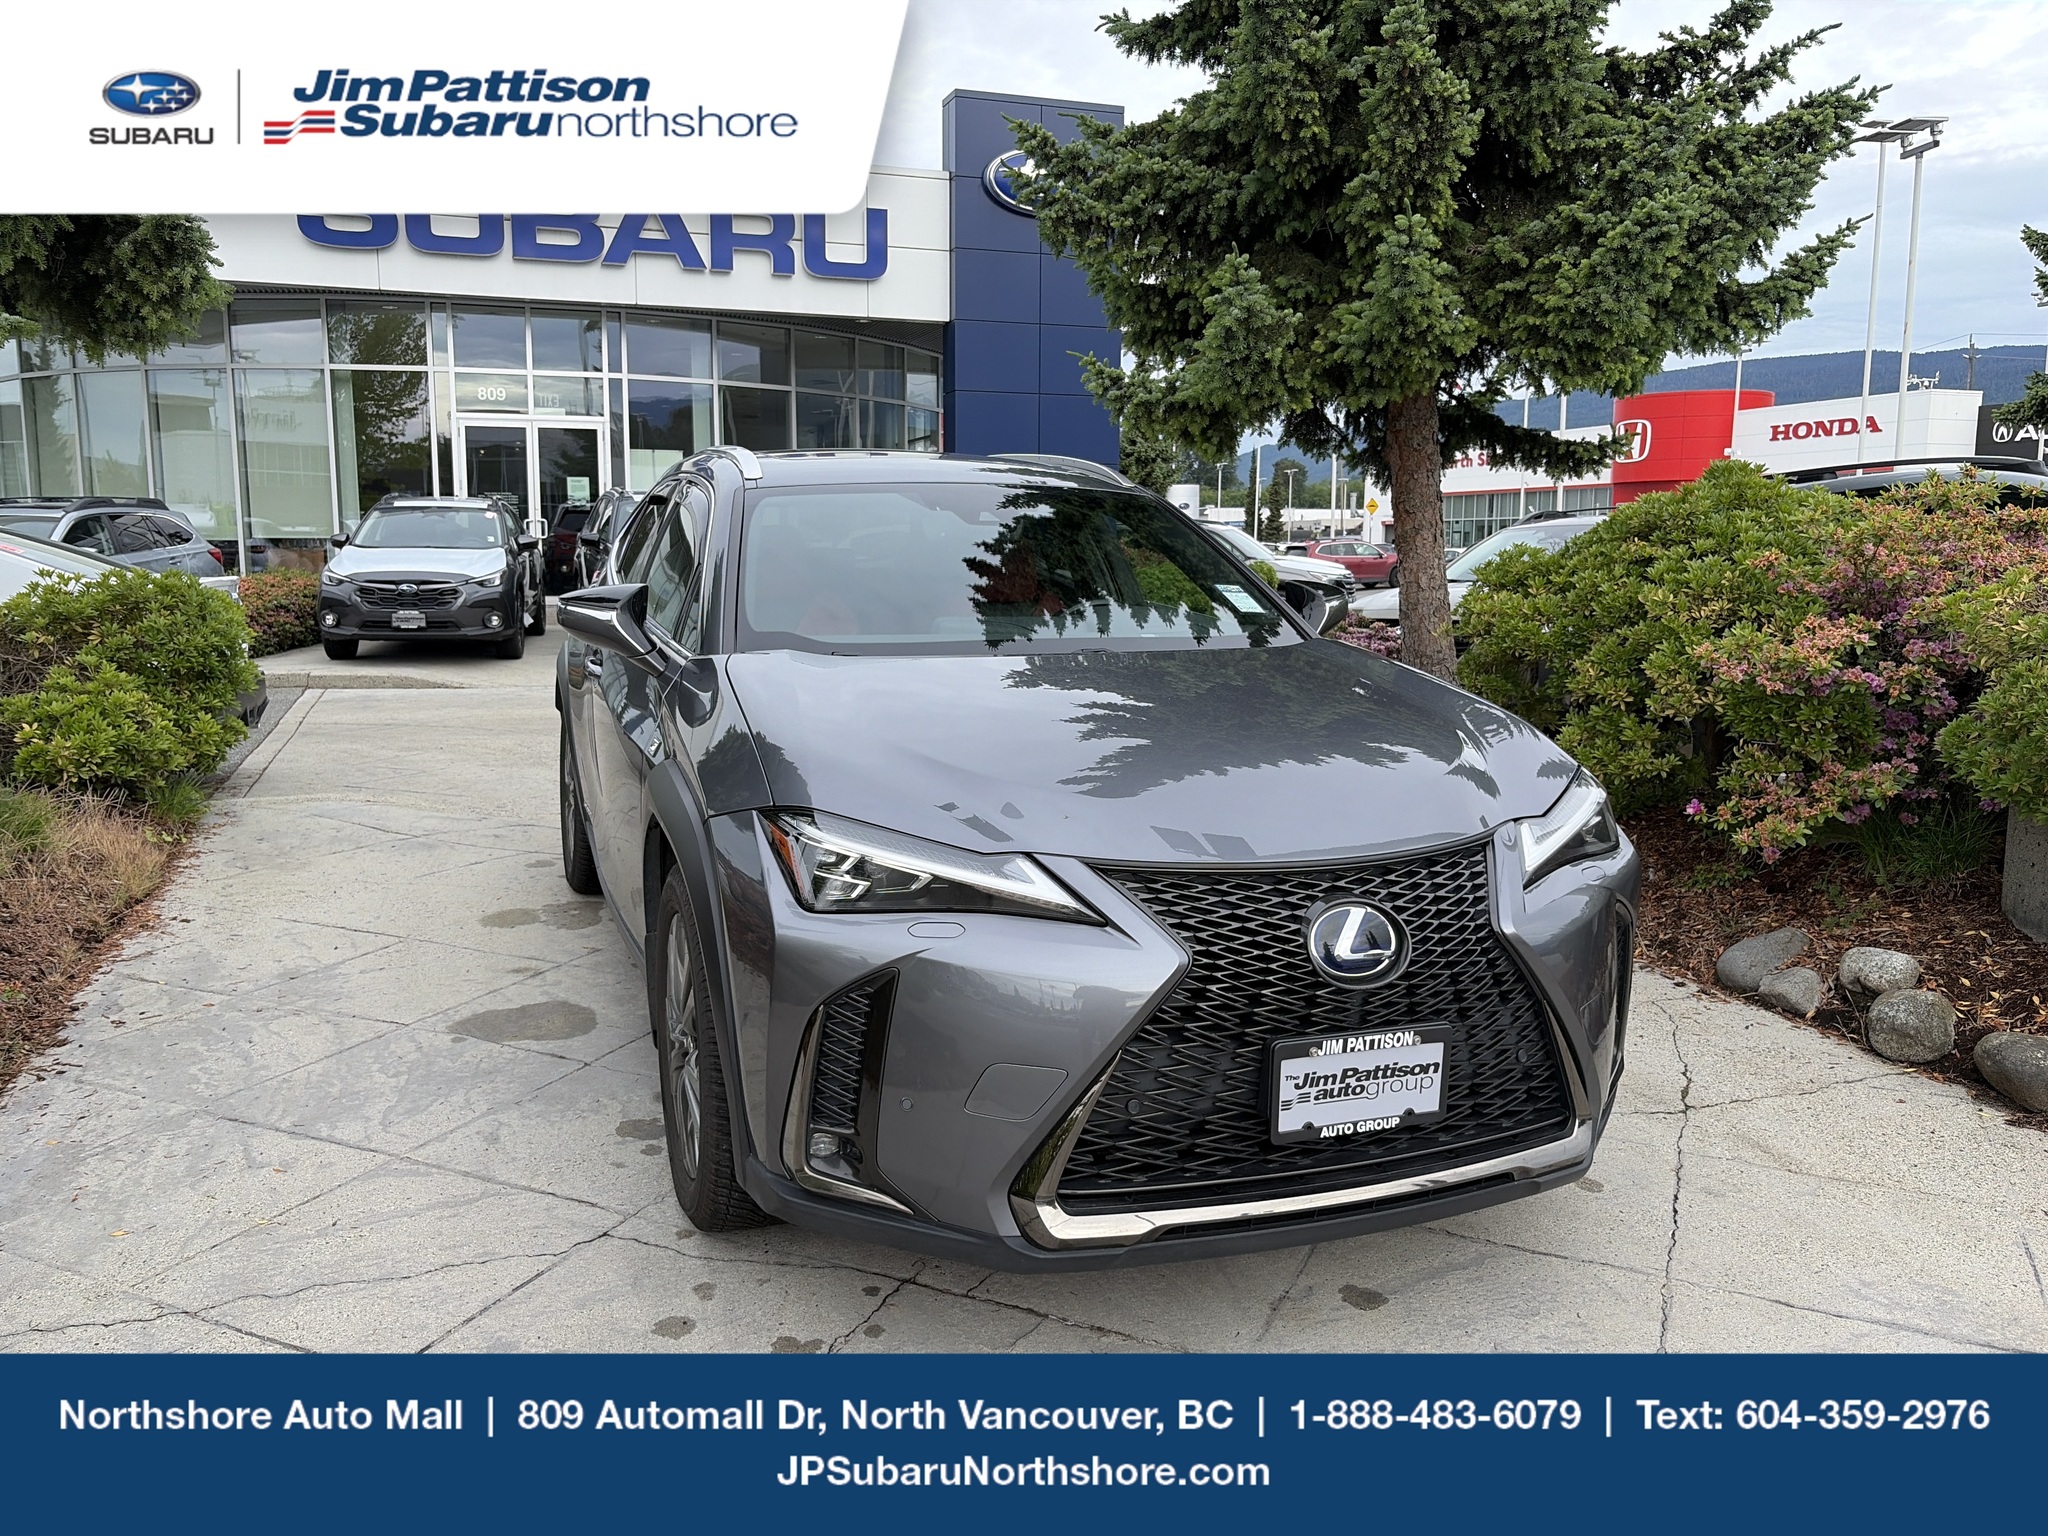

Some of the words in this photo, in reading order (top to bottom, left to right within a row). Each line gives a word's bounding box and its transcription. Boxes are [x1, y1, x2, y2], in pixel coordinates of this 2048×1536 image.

[296, 207, 889, 281] SUBARU
[477, 387, 507, 401] 809
[1769, 415, 1883, 442] HONDA
[1317, 1038, 1343, 1057] JIM
[1346, 1031, 1414, 1053] PATTISON
[1285, 1074, 1300, 1082] The
[1320, 1122, 1354, 1139] AUTO
[1356, 1117, 1400, 1134] GROUP
